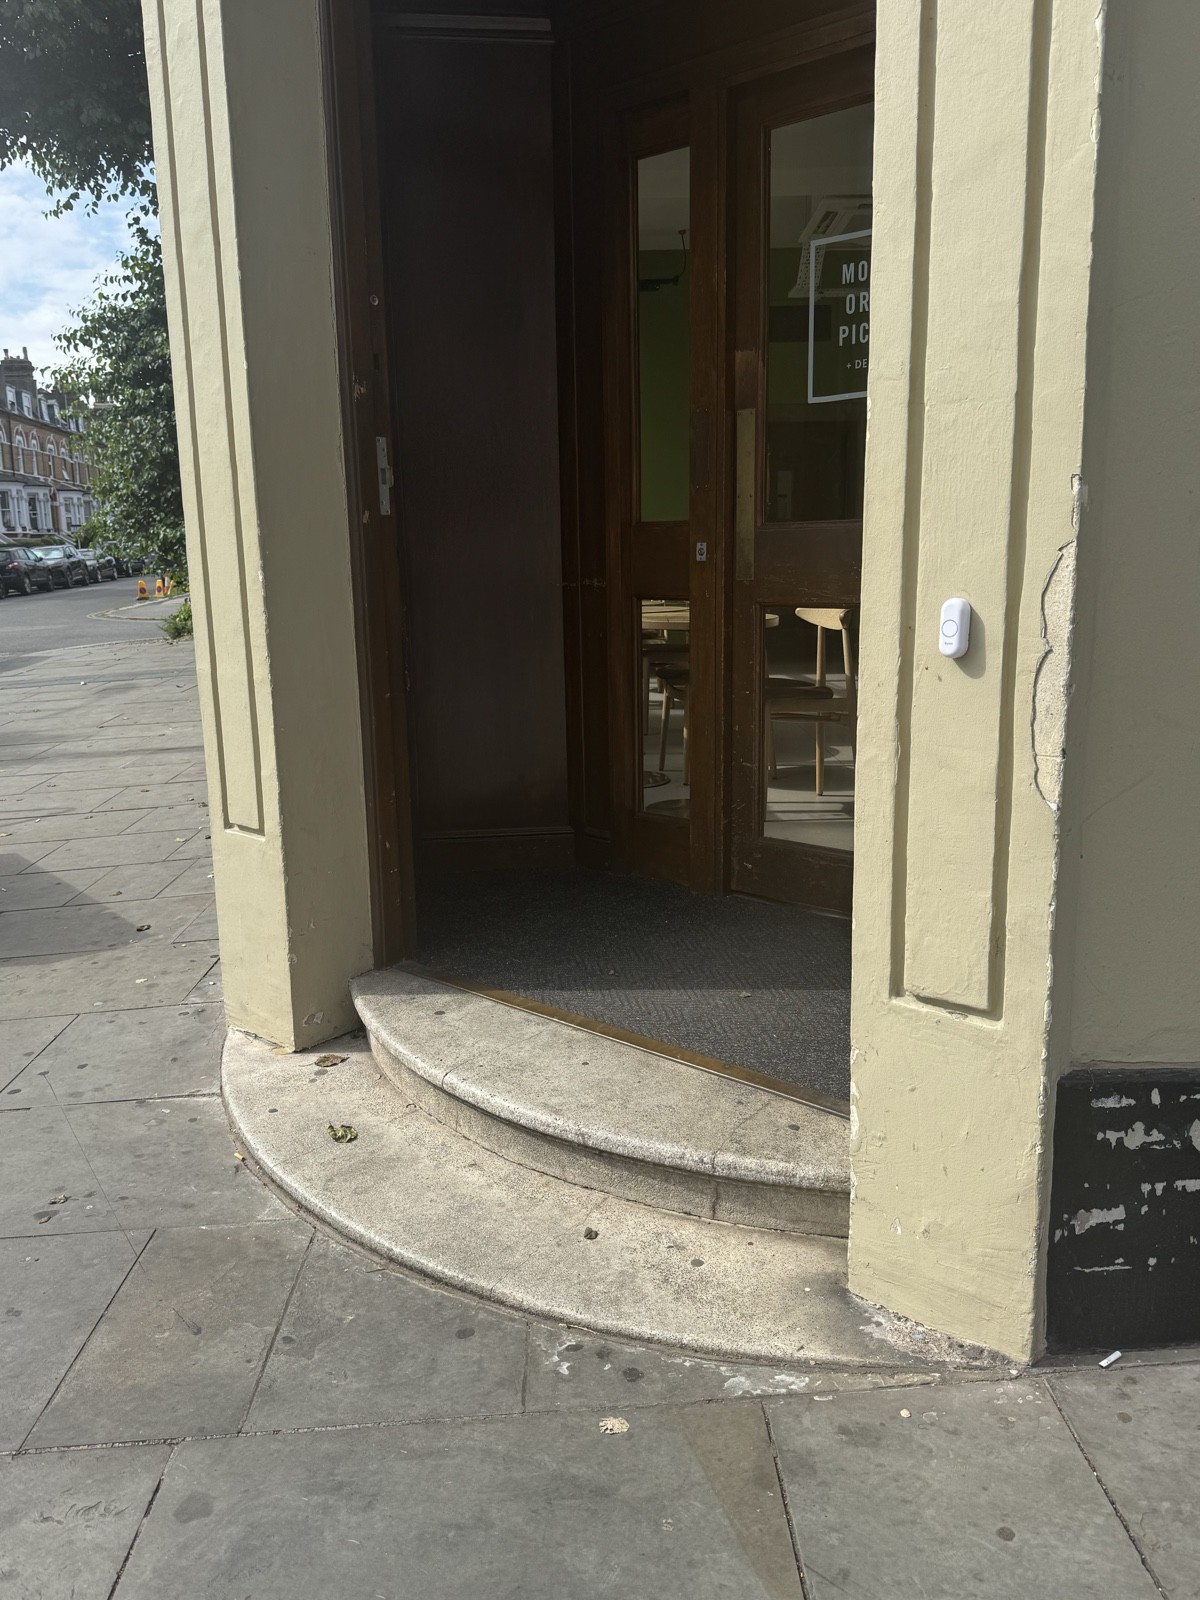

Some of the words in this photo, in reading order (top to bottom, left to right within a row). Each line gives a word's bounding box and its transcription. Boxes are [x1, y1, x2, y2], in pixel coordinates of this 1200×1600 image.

[842, 260, 868, 285] MO
[845, 291, 869, 315] OR
[839, 322, 869, 347] PIC
[854, 358, 868, 369] DE
